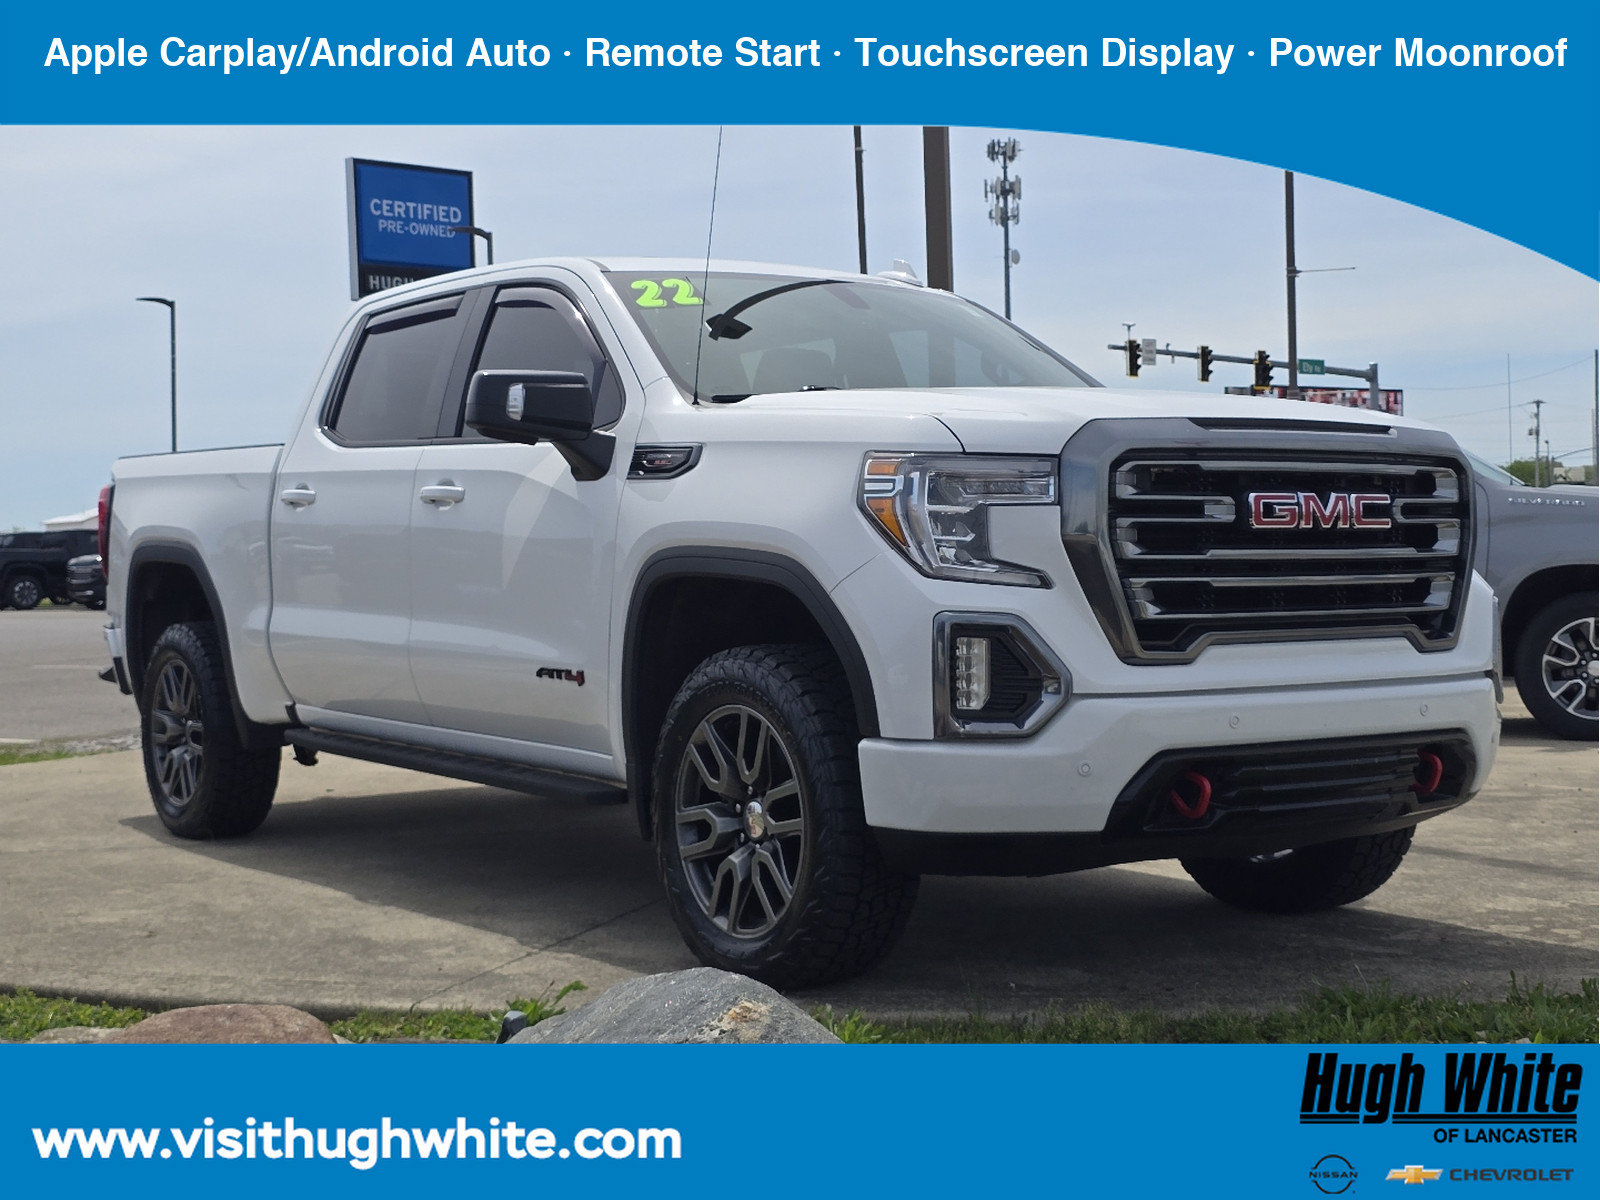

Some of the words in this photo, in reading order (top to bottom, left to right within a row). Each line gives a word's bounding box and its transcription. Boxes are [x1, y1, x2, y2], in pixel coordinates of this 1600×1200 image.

[369, 198, 462, 223] CERTIFIED
[378, 219, 456, 238] PRE-OWNED
[630, 278, 704, 307] 22
[1248, 492, 1392, 528] GMC
[536, 667, 585, 687] AT4
